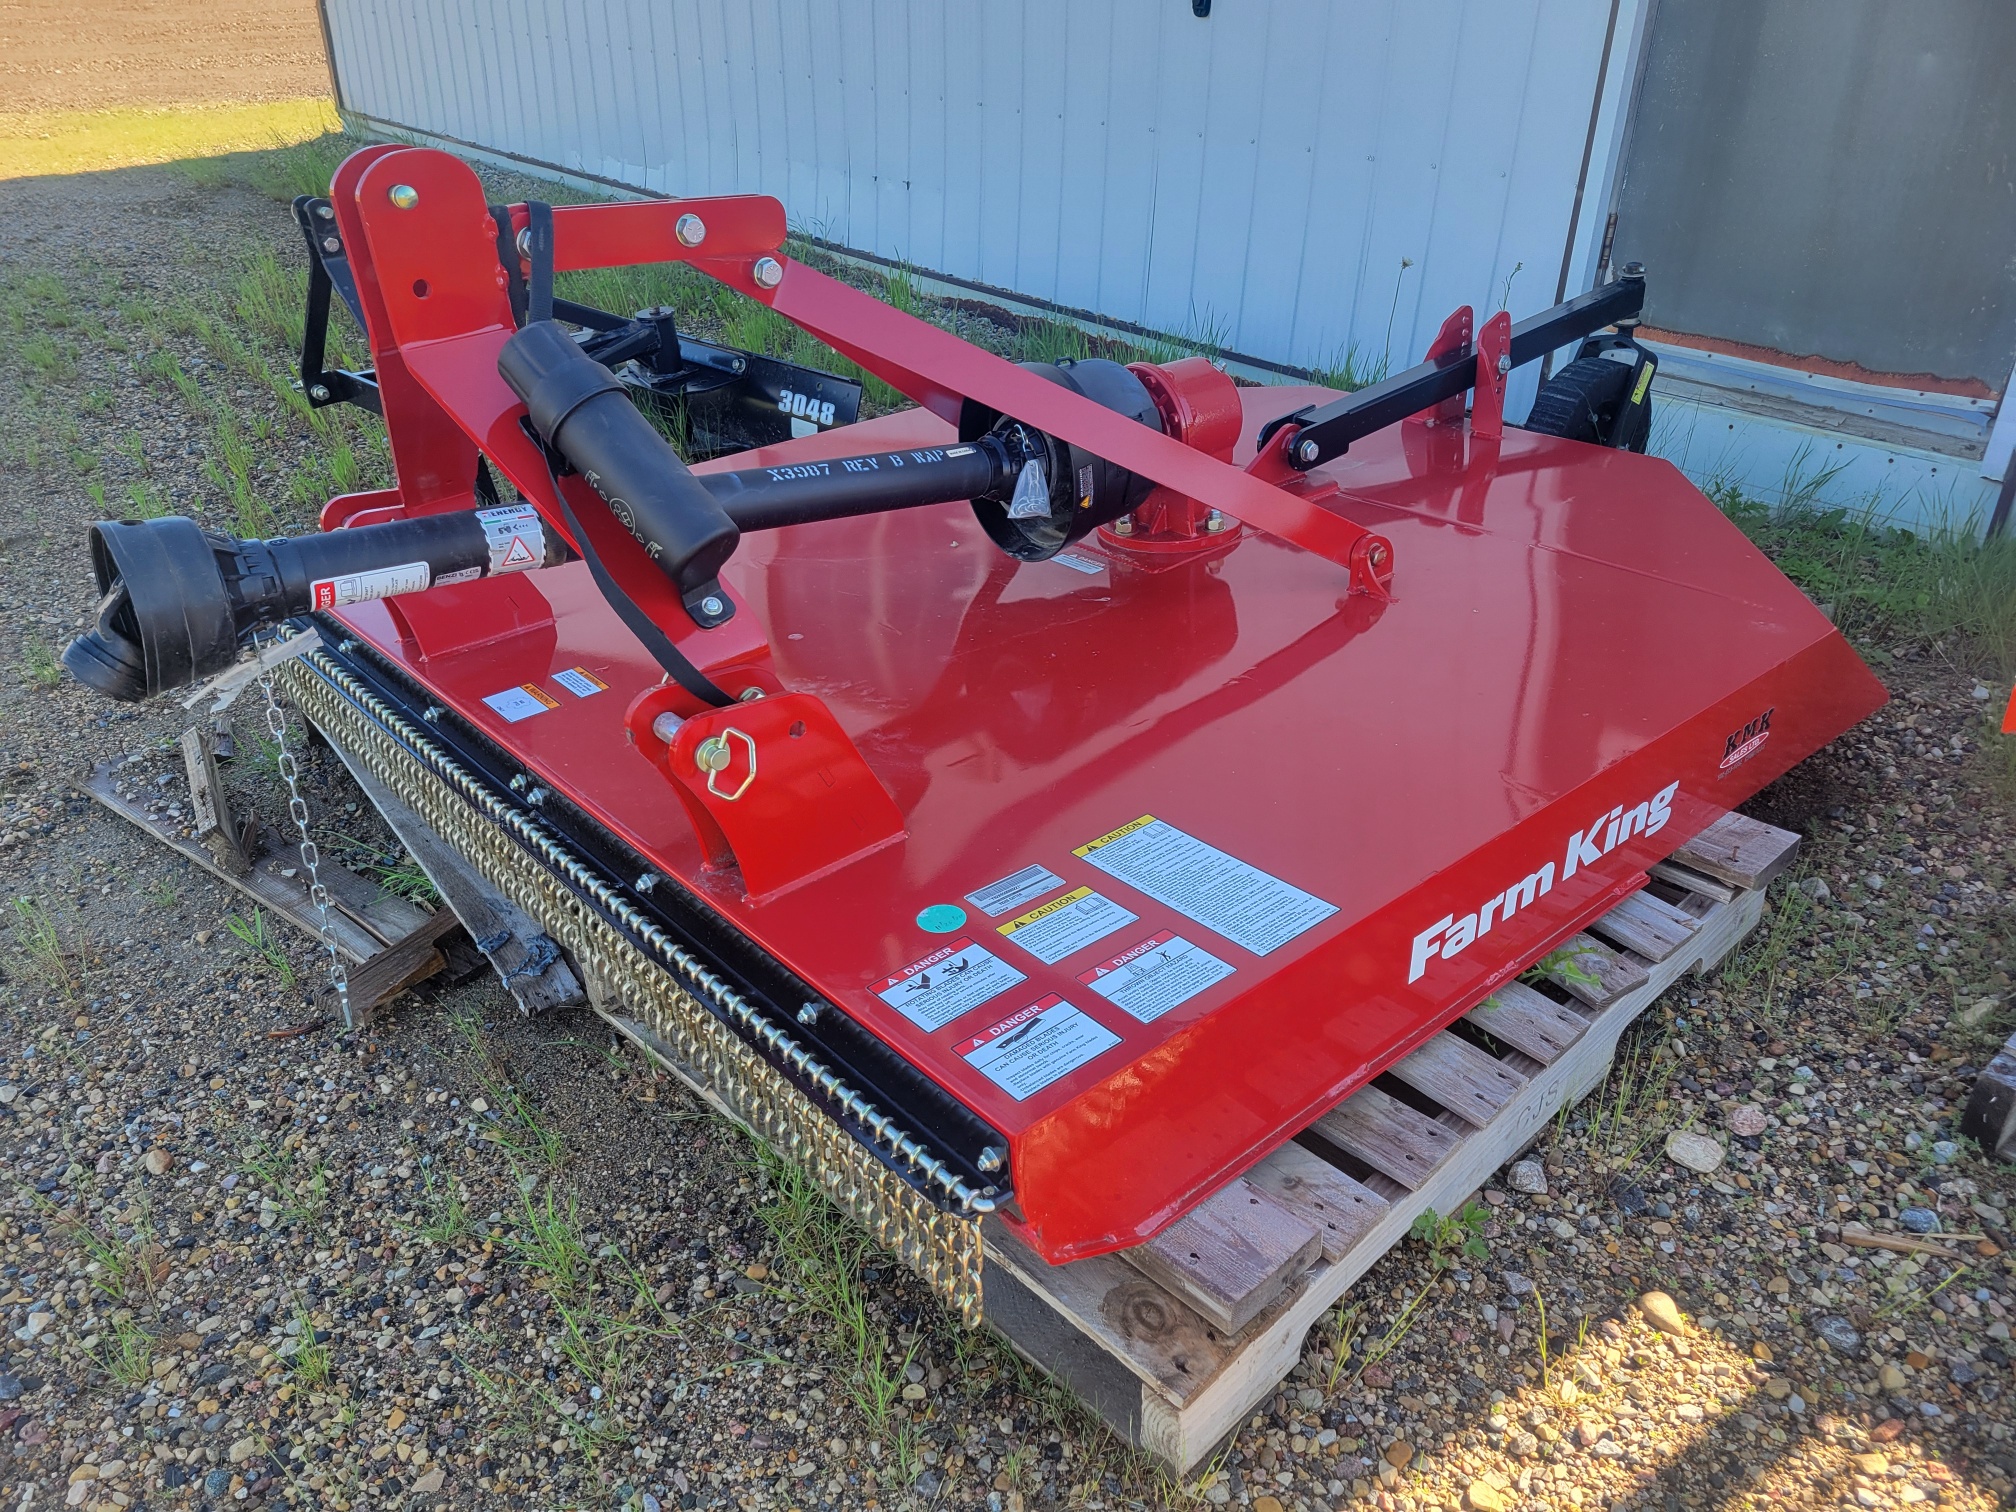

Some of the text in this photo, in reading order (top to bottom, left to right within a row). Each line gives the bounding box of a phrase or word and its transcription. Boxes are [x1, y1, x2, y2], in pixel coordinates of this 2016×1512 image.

[778, 389, 836, 426] 3048
[842, 457, 879, 473] REV
[888, 454, 904, 467] B
[490, 506, 528, 517] ENERGY
[1729, 745, 1749, 763] SALES
[1098, 821, 1144, 844] CAUTION
[1408, 861, 1555, 985] Farm
[1562, 780, 1680, 881] King
[1027, 895, 1077, 920] CAUTION
[903, 947, 955, 976] DANGER
[1112, 939, 1161, 966] DANGER
[905, 959, 994, 1007] ROTATING BLADES CAN CAUSE
[915, 992, 943, 1008] SERIOUS
[941, 981, 964, 994] INJURY
[972, 965, 994, 977] DEATH
[1120, 955, 1189, 994] THROWN OBJECT HAZARD
[988, 1004, 1044, 1036] DANGER
[993, 1022, 1080, 1072] CAN CAUSE SERIOUS INJURY
[1004, 1027, 1061, 1060] DAMAGED BLADES
[1037, 1041, 1060, 1055] DEATH
